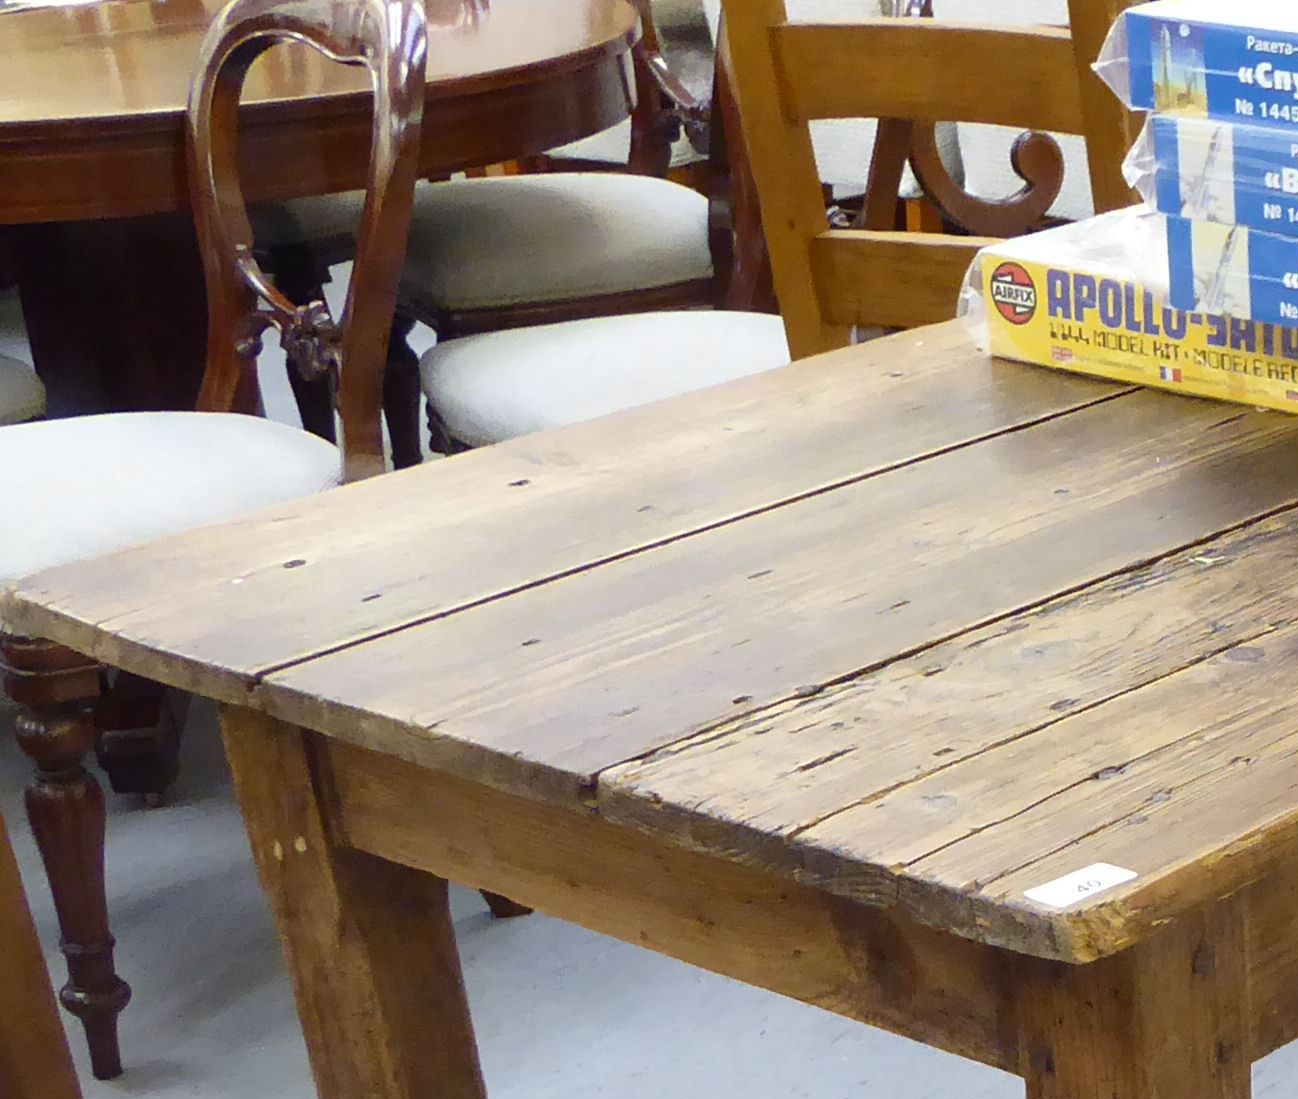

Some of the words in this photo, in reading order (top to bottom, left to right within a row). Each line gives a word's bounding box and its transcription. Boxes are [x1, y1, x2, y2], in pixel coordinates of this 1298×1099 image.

[1235, 97, 1254, 116] №
[1263, 202, 1282, 219] №
[994, 284, 1034, 304] AIRFIX
[1279, 301, 1298, 319] №
[1093, 329, 1149, 356] MODEL
[1152, 339, 1180, 361] KIT
